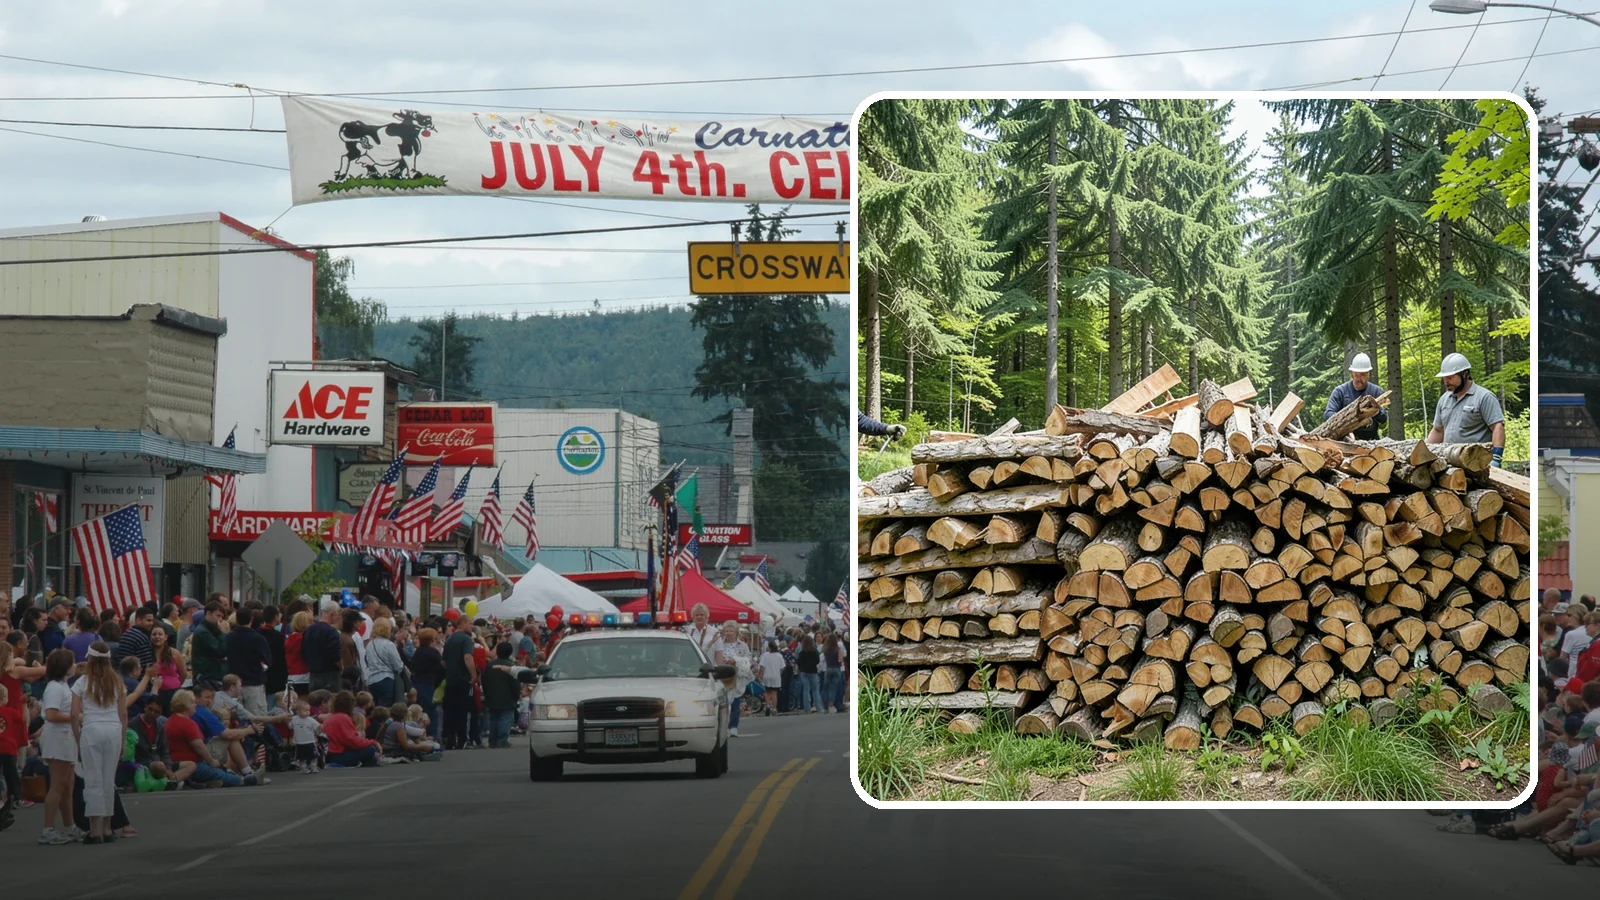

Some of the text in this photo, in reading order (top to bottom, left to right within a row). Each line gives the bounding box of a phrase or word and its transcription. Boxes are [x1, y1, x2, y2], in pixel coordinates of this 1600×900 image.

[481, 141, 605, 193] JULY
[632, 150, 746, 198] 4th.
[696, 254, 850, 280] CROSSWA
[282, 380, 373, 420] ACE
[405, 409, 452, 422] CEDAR
[283, 421, 371, 436] Hardware
[416, 428, 477, 447] Coca-Cola
[353, 467, 386, 480] Simpl
[83, 484, 155, 496] St. Vincent de Paul
[688, 526, 741, 535] CRNATION
[699, 535, 731, 543] GLASS
